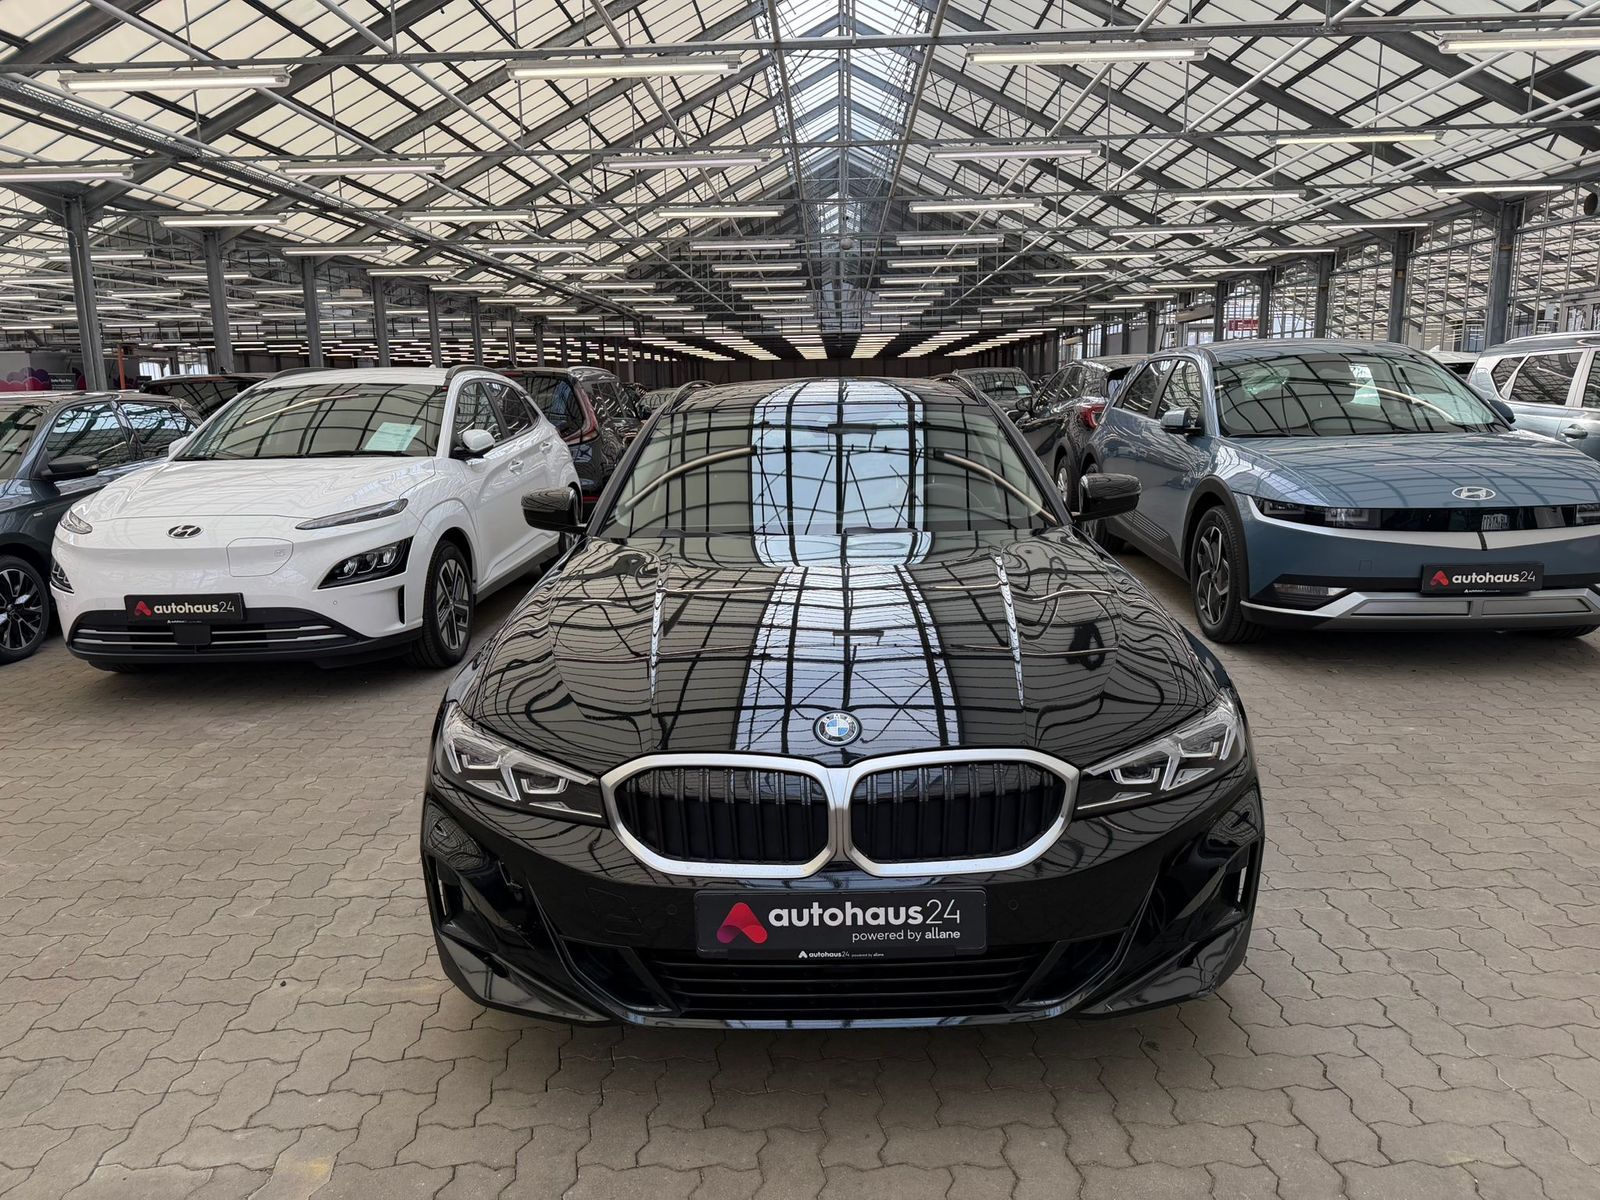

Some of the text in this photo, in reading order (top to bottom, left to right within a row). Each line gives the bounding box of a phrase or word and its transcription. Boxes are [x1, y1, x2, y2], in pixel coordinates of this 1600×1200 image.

[1452, 570, 1536, 583] autohaus24
[154, 601, 235, 614] autohaus24
[768, 899, 960, 926] autohaus24
[852, 928, 960, 943] powered by allane
[808, 950, 850, 958] autohaus24
